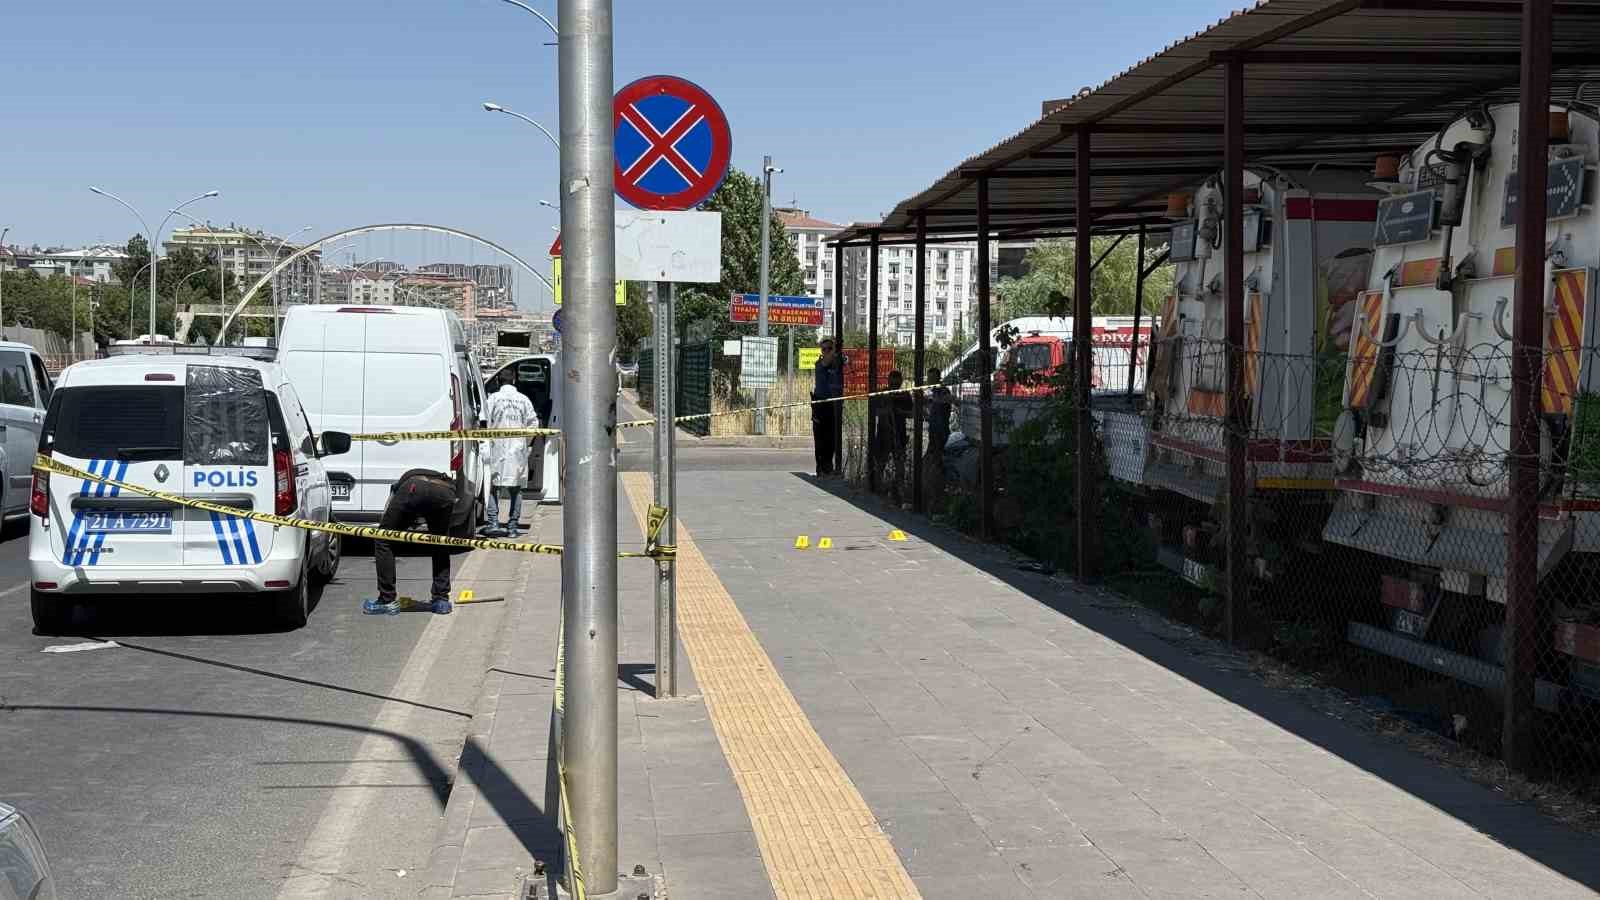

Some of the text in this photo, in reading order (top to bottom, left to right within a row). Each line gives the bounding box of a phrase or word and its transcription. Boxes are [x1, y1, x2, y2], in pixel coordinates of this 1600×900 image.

[193, 466, 258, 487] POLİS
[90, 512, 167, 529] 21 A 7291
